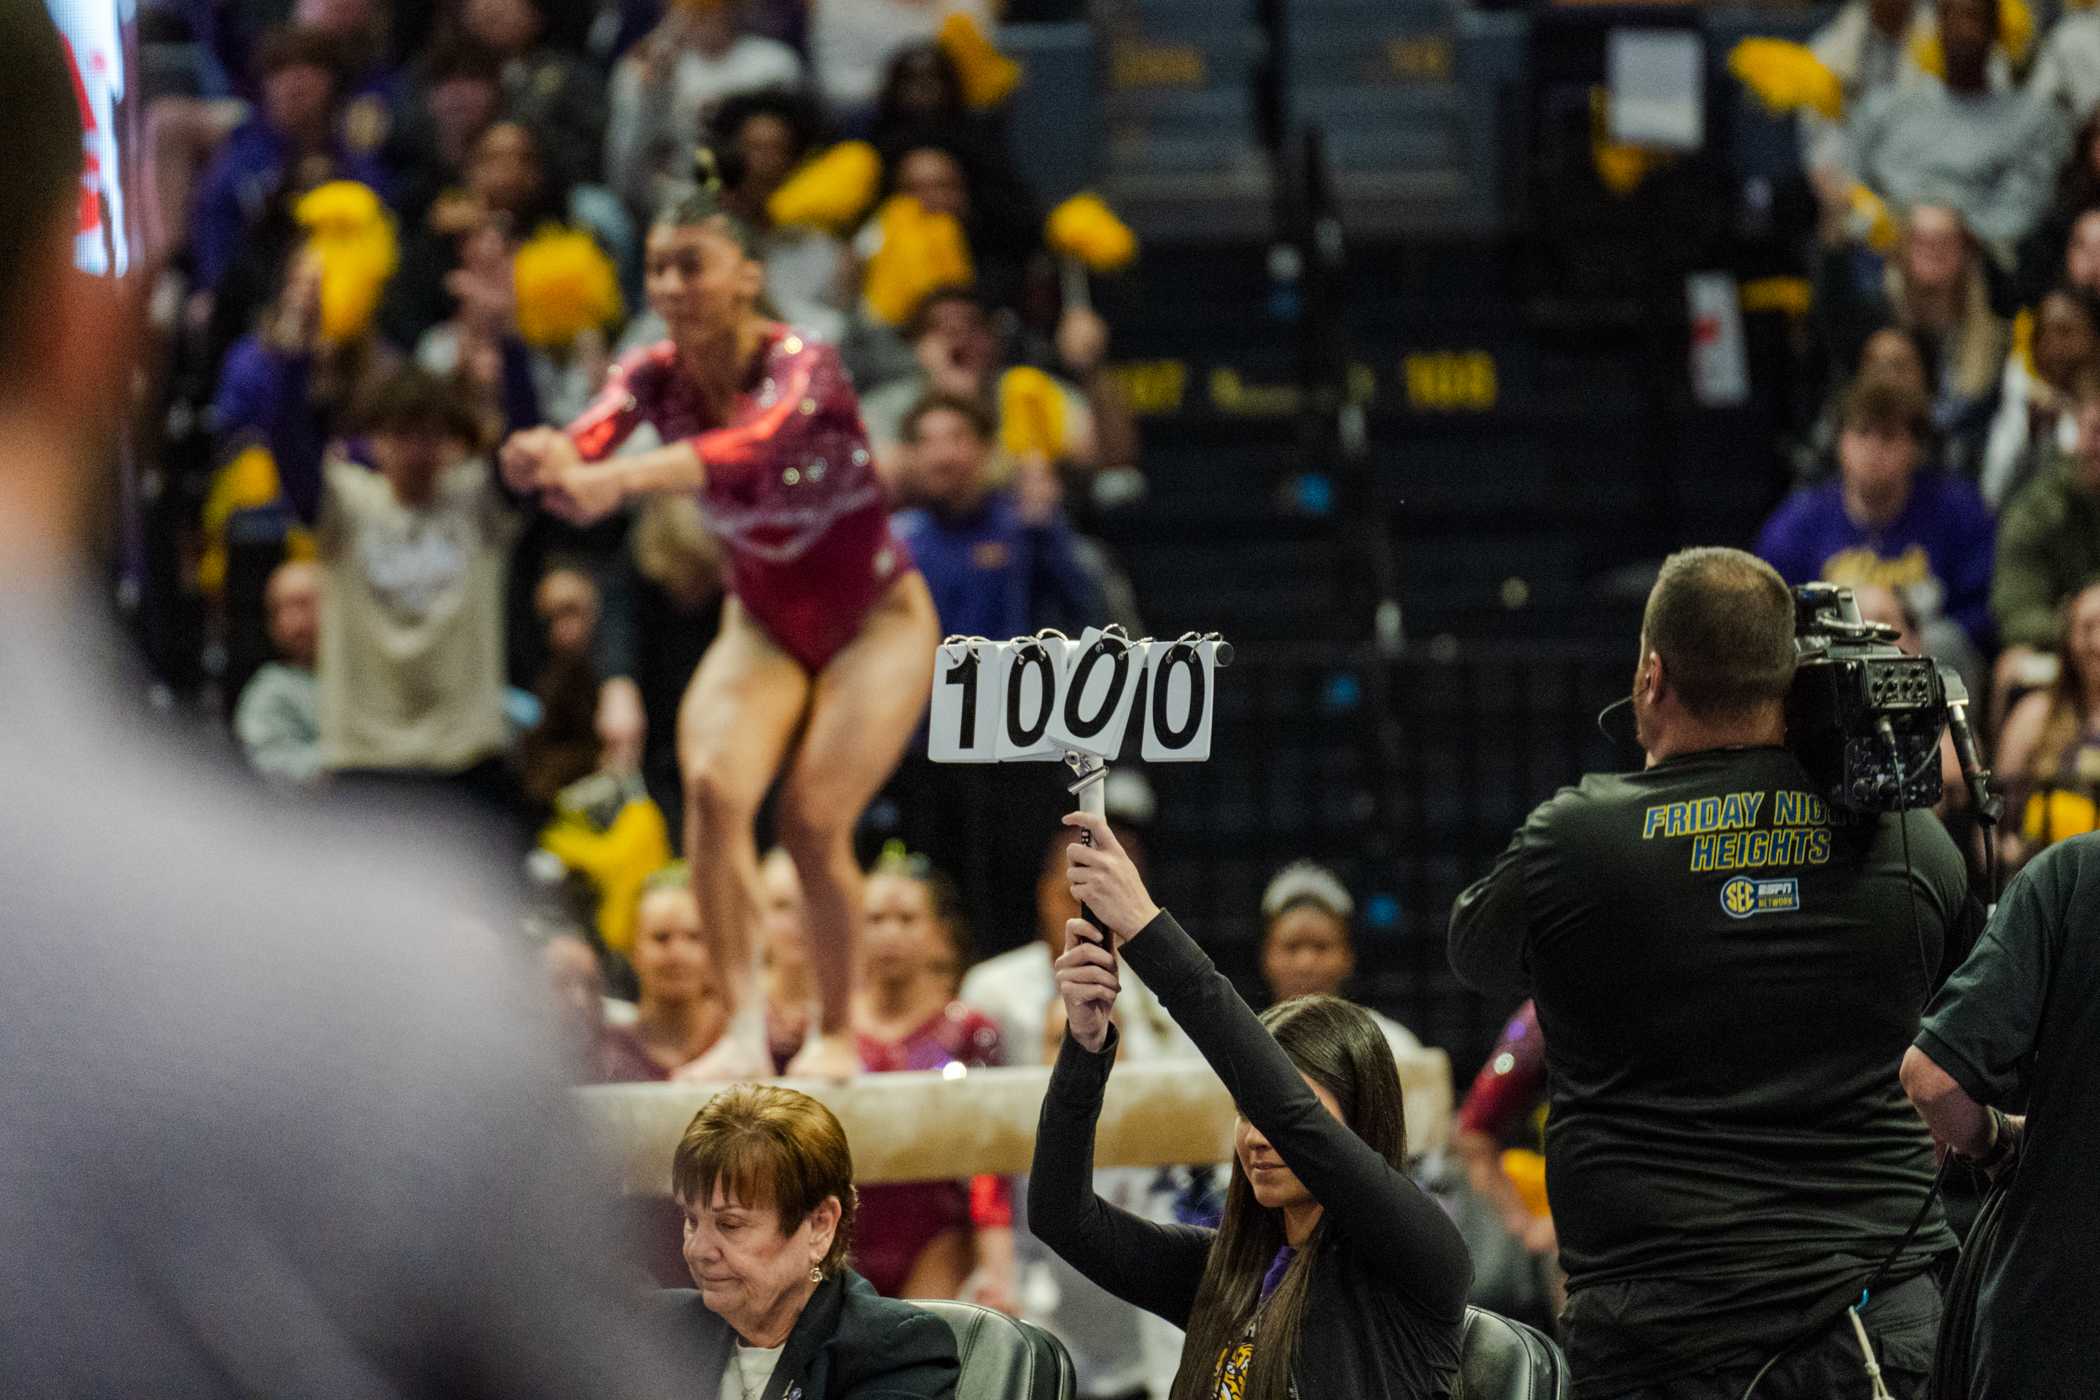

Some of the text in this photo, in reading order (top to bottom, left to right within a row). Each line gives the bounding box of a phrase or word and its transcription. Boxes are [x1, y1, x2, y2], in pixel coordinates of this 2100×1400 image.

[1642, 791, 1764, 839] FRIDAY
[1691, 829, 1832, 871] HEIGHTS
[1726, 880, 1755, 913] SEC
[1758, 883, 1793, 895] ESPN
